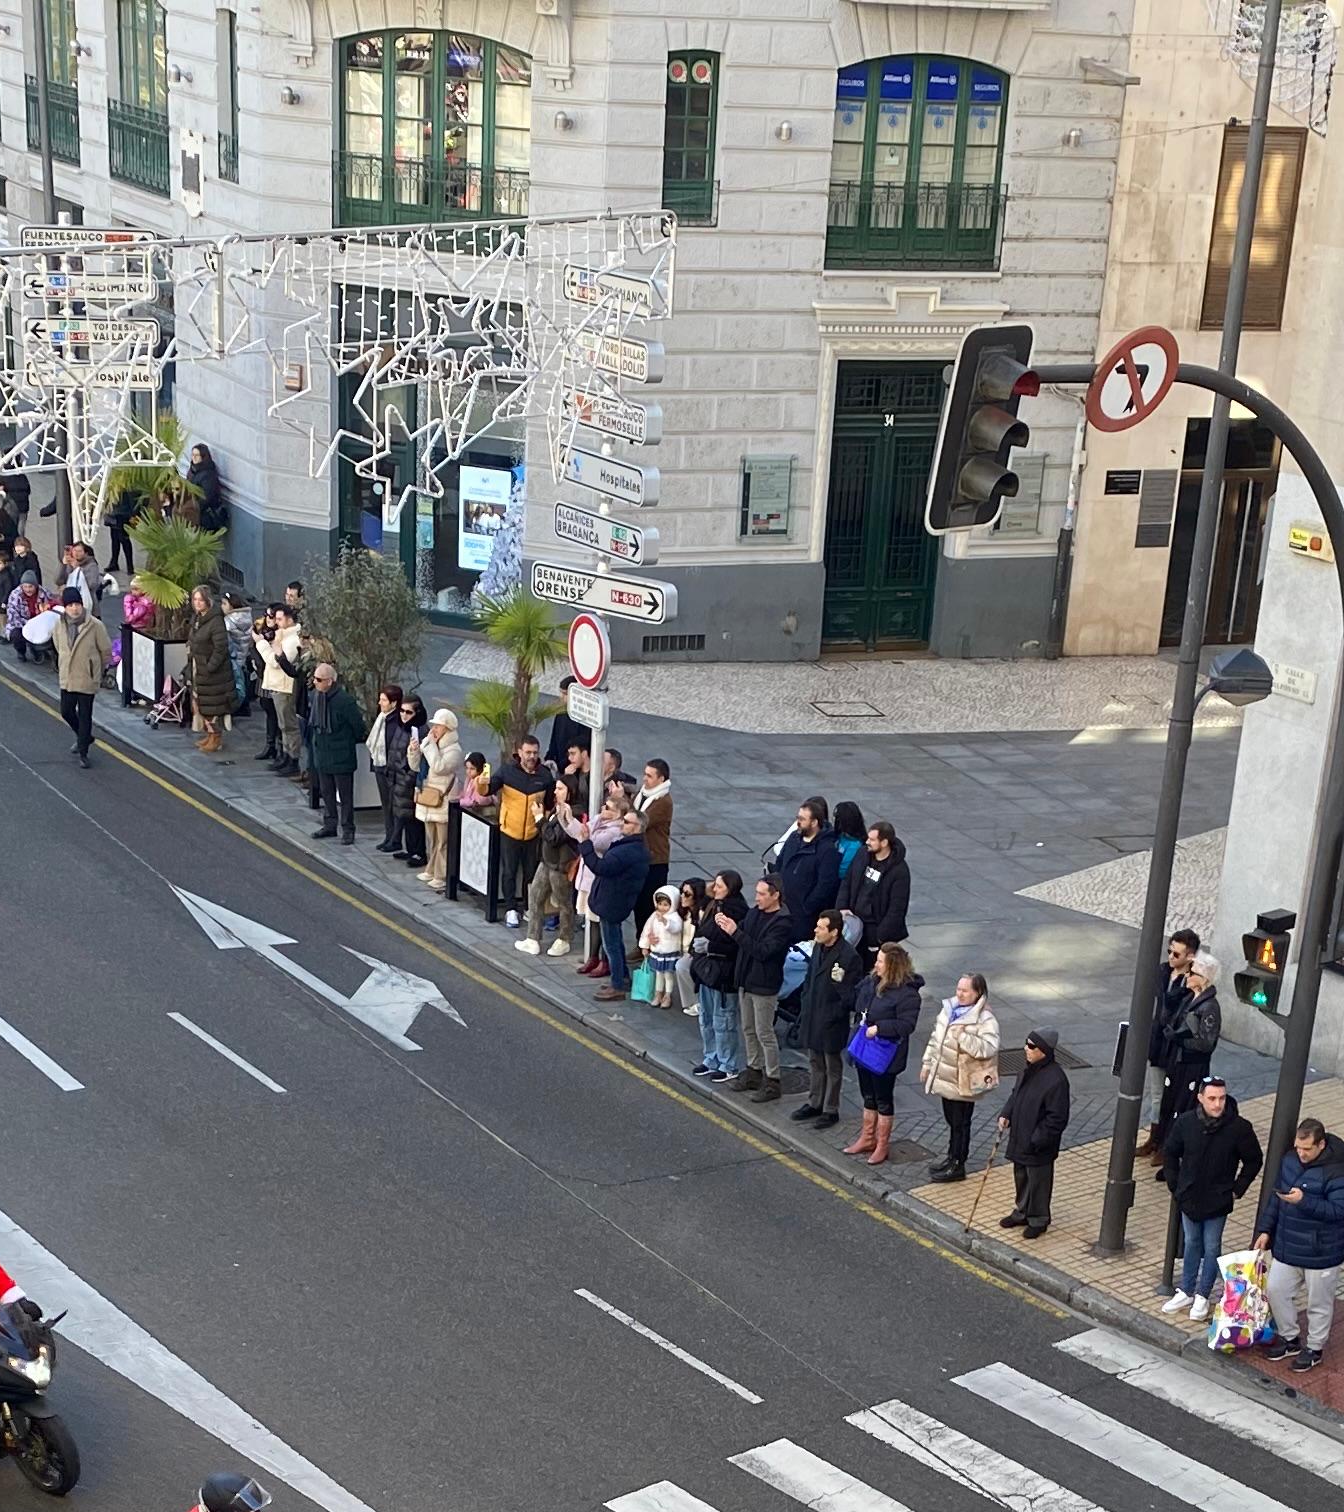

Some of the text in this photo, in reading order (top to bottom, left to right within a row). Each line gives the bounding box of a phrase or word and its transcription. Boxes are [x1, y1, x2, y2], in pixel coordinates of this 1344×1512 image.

[24, 232, 103, 242] FUENTESAUCO
[598, 414, 644, 438] FERMOSELLE
[884, 414, 895, 427] 34
[600, 468, 641, 494] Hospitales
[557, 519, 600, 546] BRAGANÇA
[537, 567, 593, 589] BENAVENTE
[536, 580, 584, 601] ORENSE
[611, 590, 642, 606] N-630
